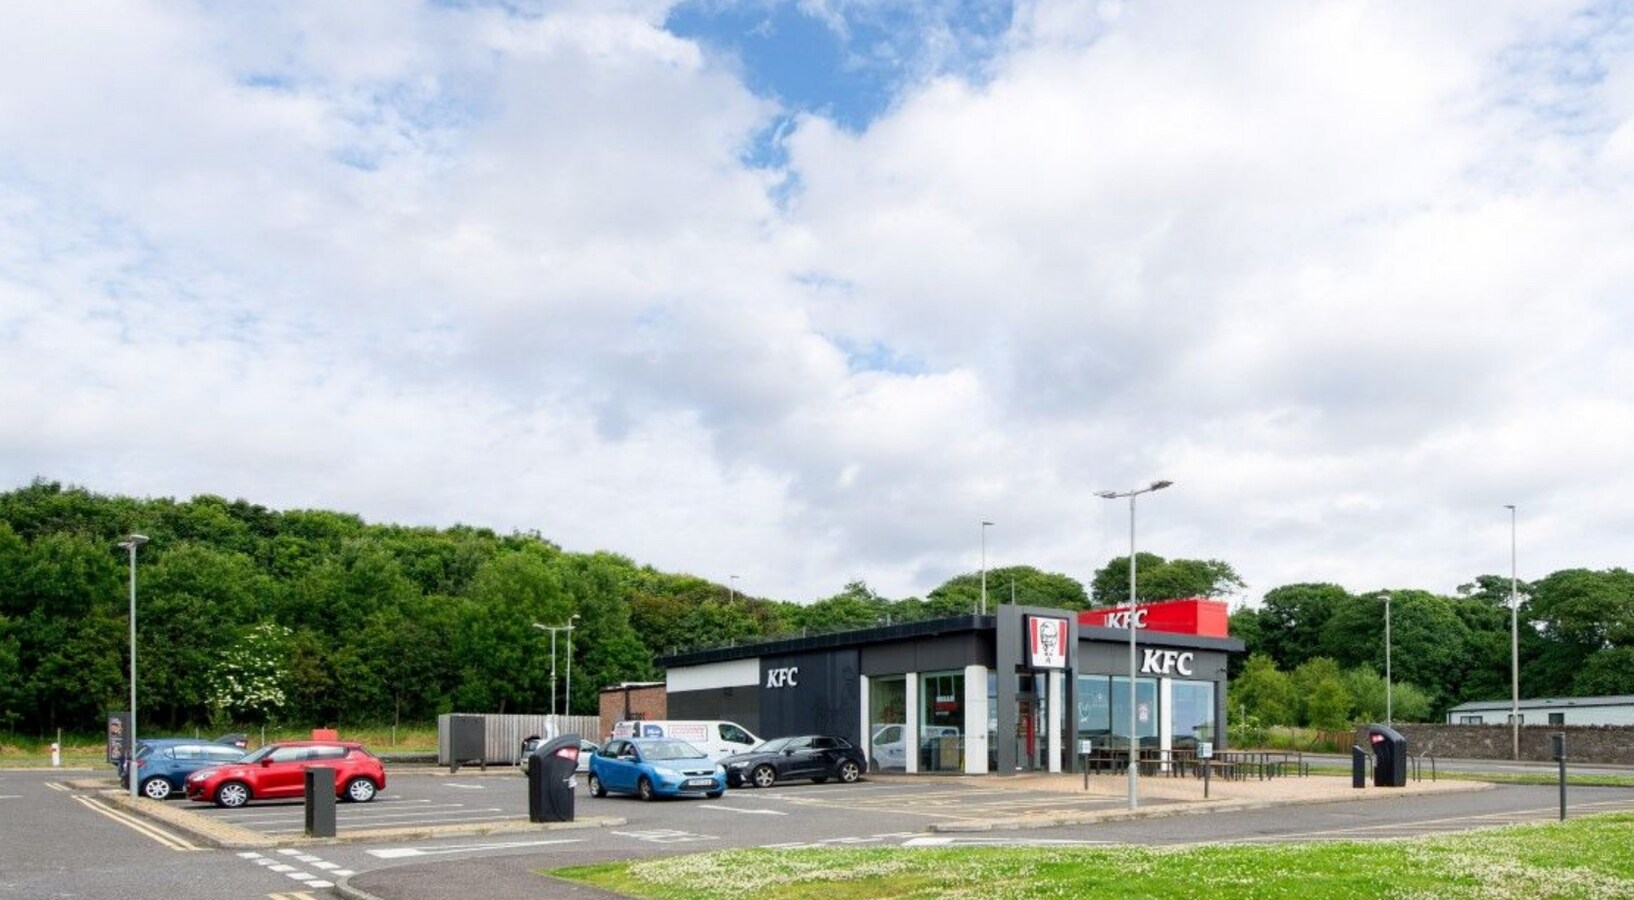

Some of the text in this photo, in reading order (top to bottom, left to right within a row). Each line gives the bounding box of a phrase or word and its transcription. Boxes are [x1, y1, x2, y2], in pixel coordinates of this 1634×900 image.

[1107, 609, 1148, 629] KFC
[1141, 649, 1194, 676] KFC
[766, 666, 799, 689] KFC
